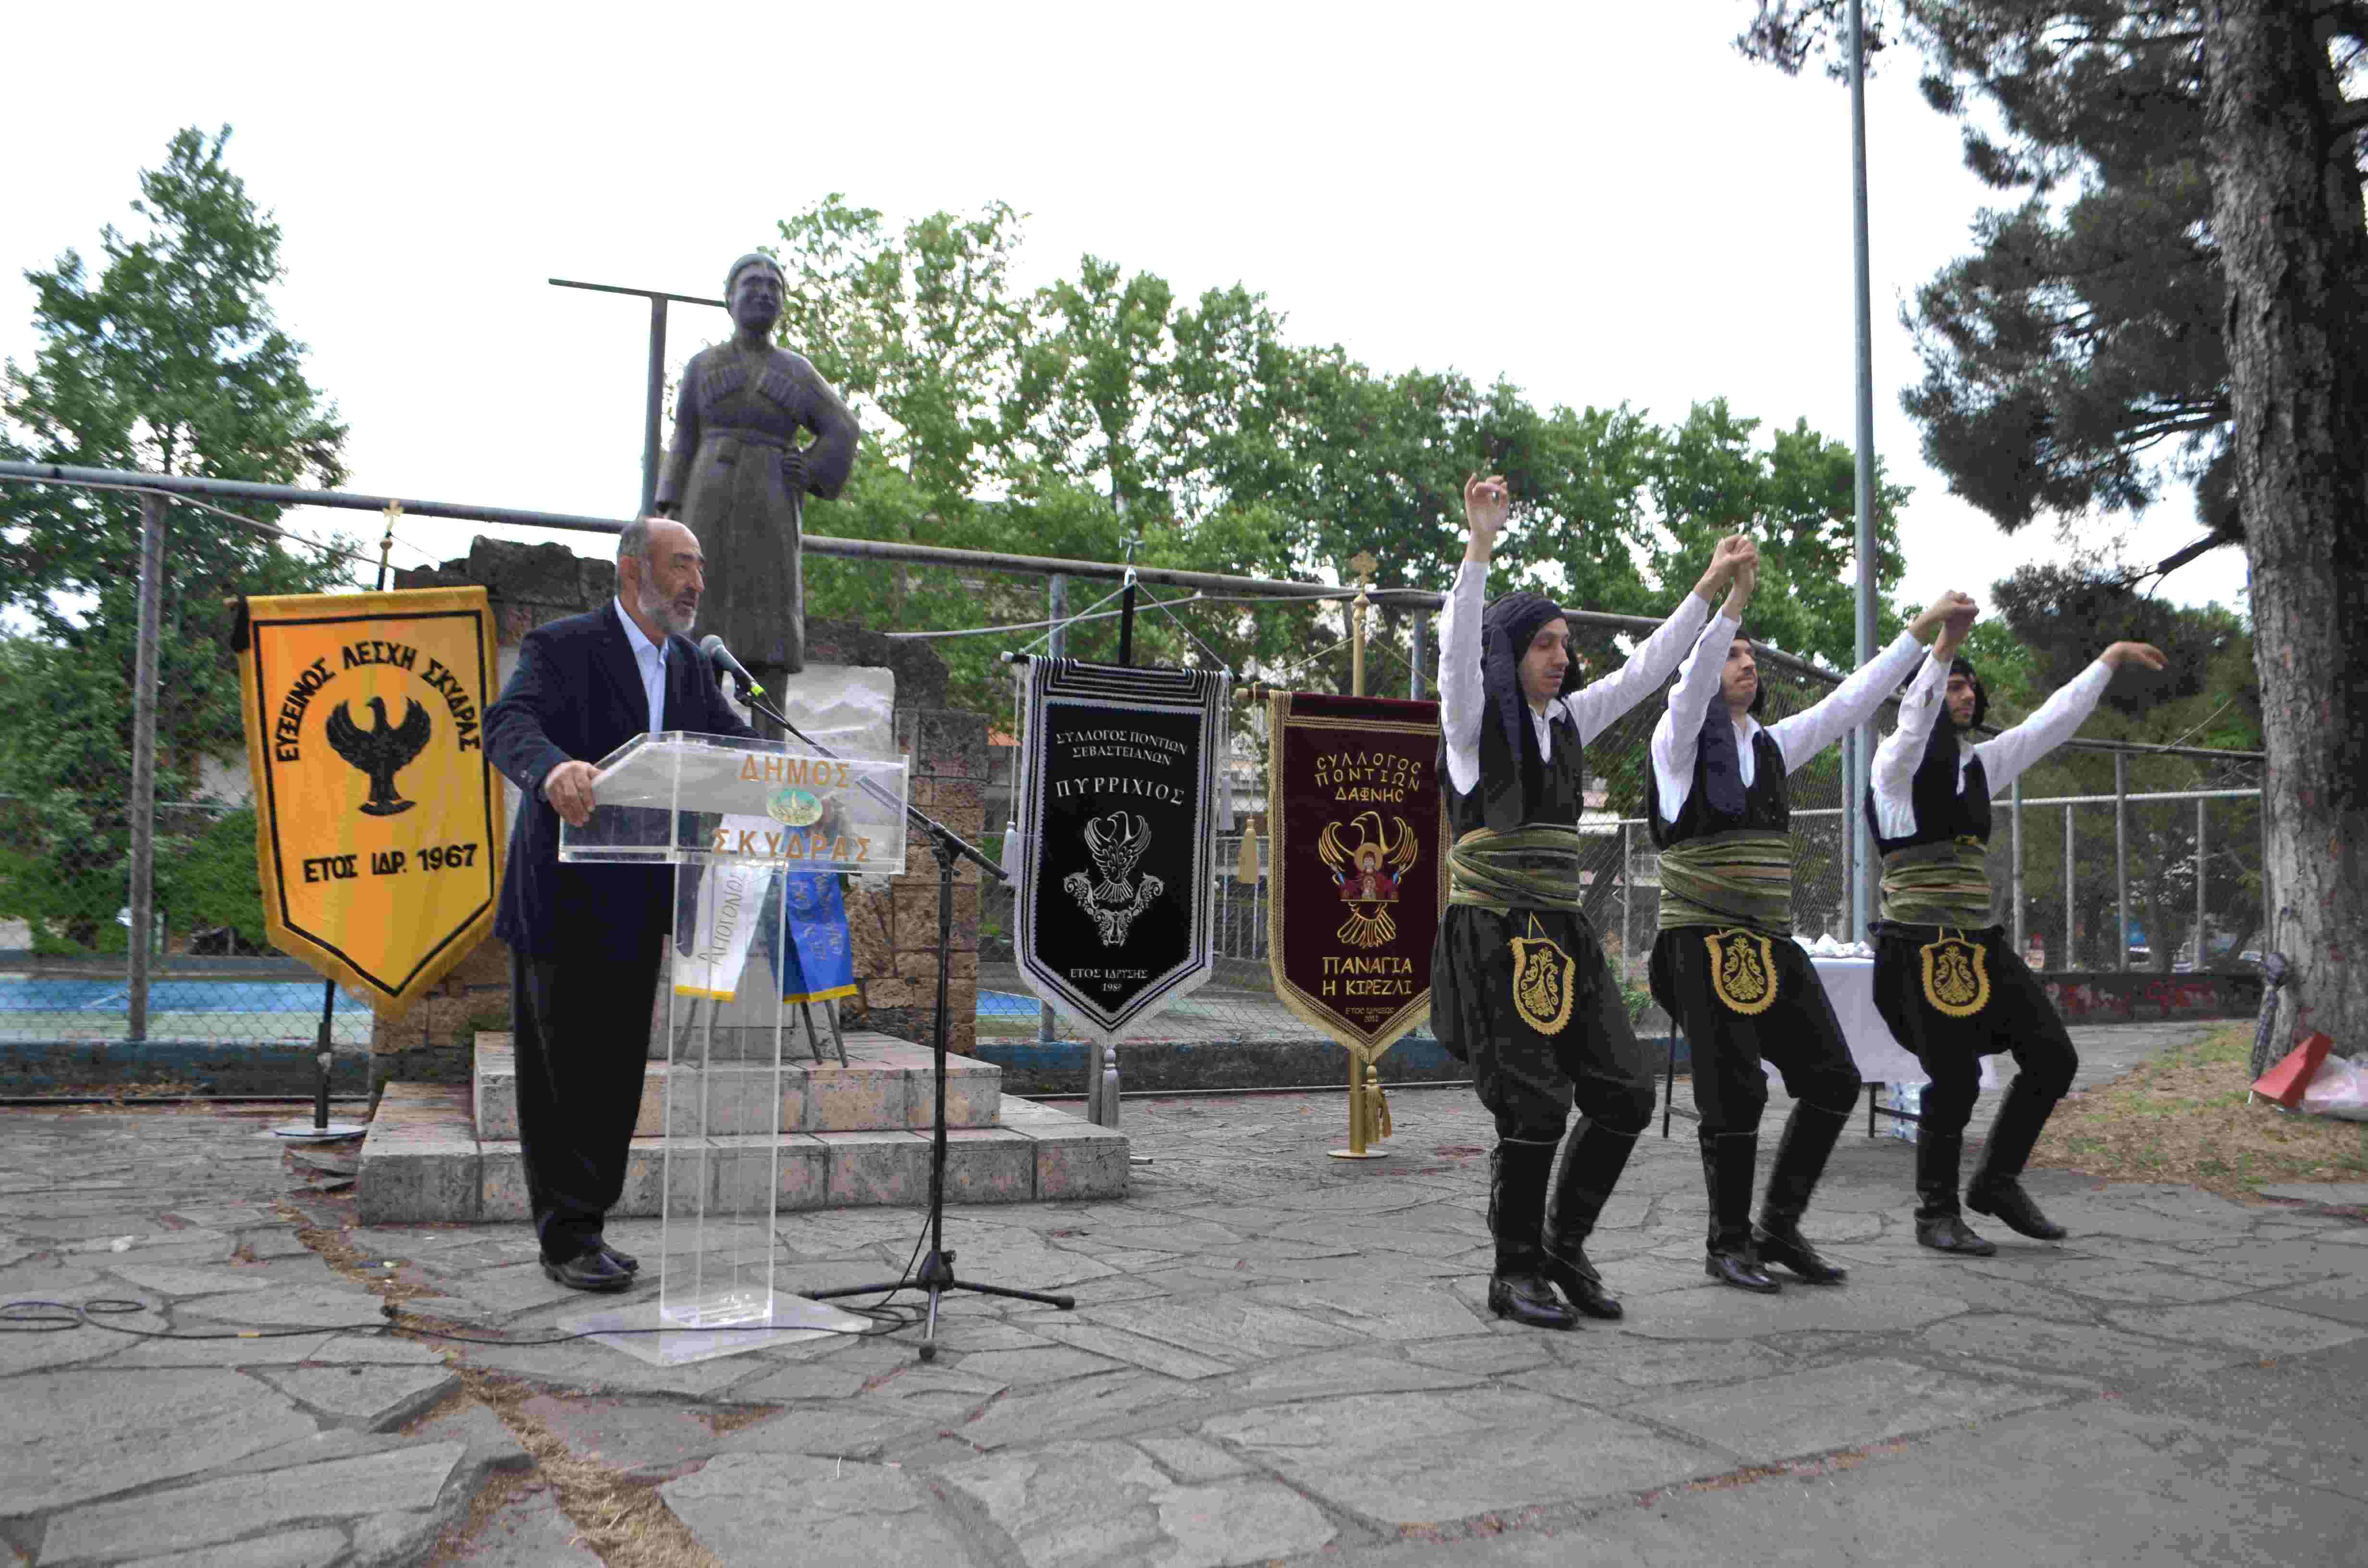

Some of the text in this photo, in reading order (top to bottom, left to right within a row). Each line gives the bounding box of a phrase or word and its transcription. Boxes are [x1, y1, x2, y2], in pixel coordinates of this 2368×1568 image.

[275, 641, 481, 763] ΕΥΞΕΙΝΟΣ ΛΕΣΧΗ ΣΚΥΔΡΑΣ
[1056, 730, 1188, 755] ΣΥΛΛΟΓΟΣ ΠΟΝΤΙΩΝ
[1073, 746, 1172, 766] ΣΕΒΑΣΤΕΙΑΝΩΝ
[738, 754, 850, 788] ΔΗΜΟΣ
[1315, 768, 1420, 791] ΠΟΝΤΙΩΝ
[1055, 777, 1184, 805] ΠΥΡΡΙΧΙΟΣ
[714, 830, 871, 862] ΣΚΥΔΡΑΣ
[303, 844, 478, 882] ΕΤΟΣ ΙΔΡ. 1967
[1070, 968, 1101, 978] ΕΤΟΣ
[1322, 956, 1413, 975] ΠΑΝΑΓΙΑ
[1322, 980, 1336, 996] Η
